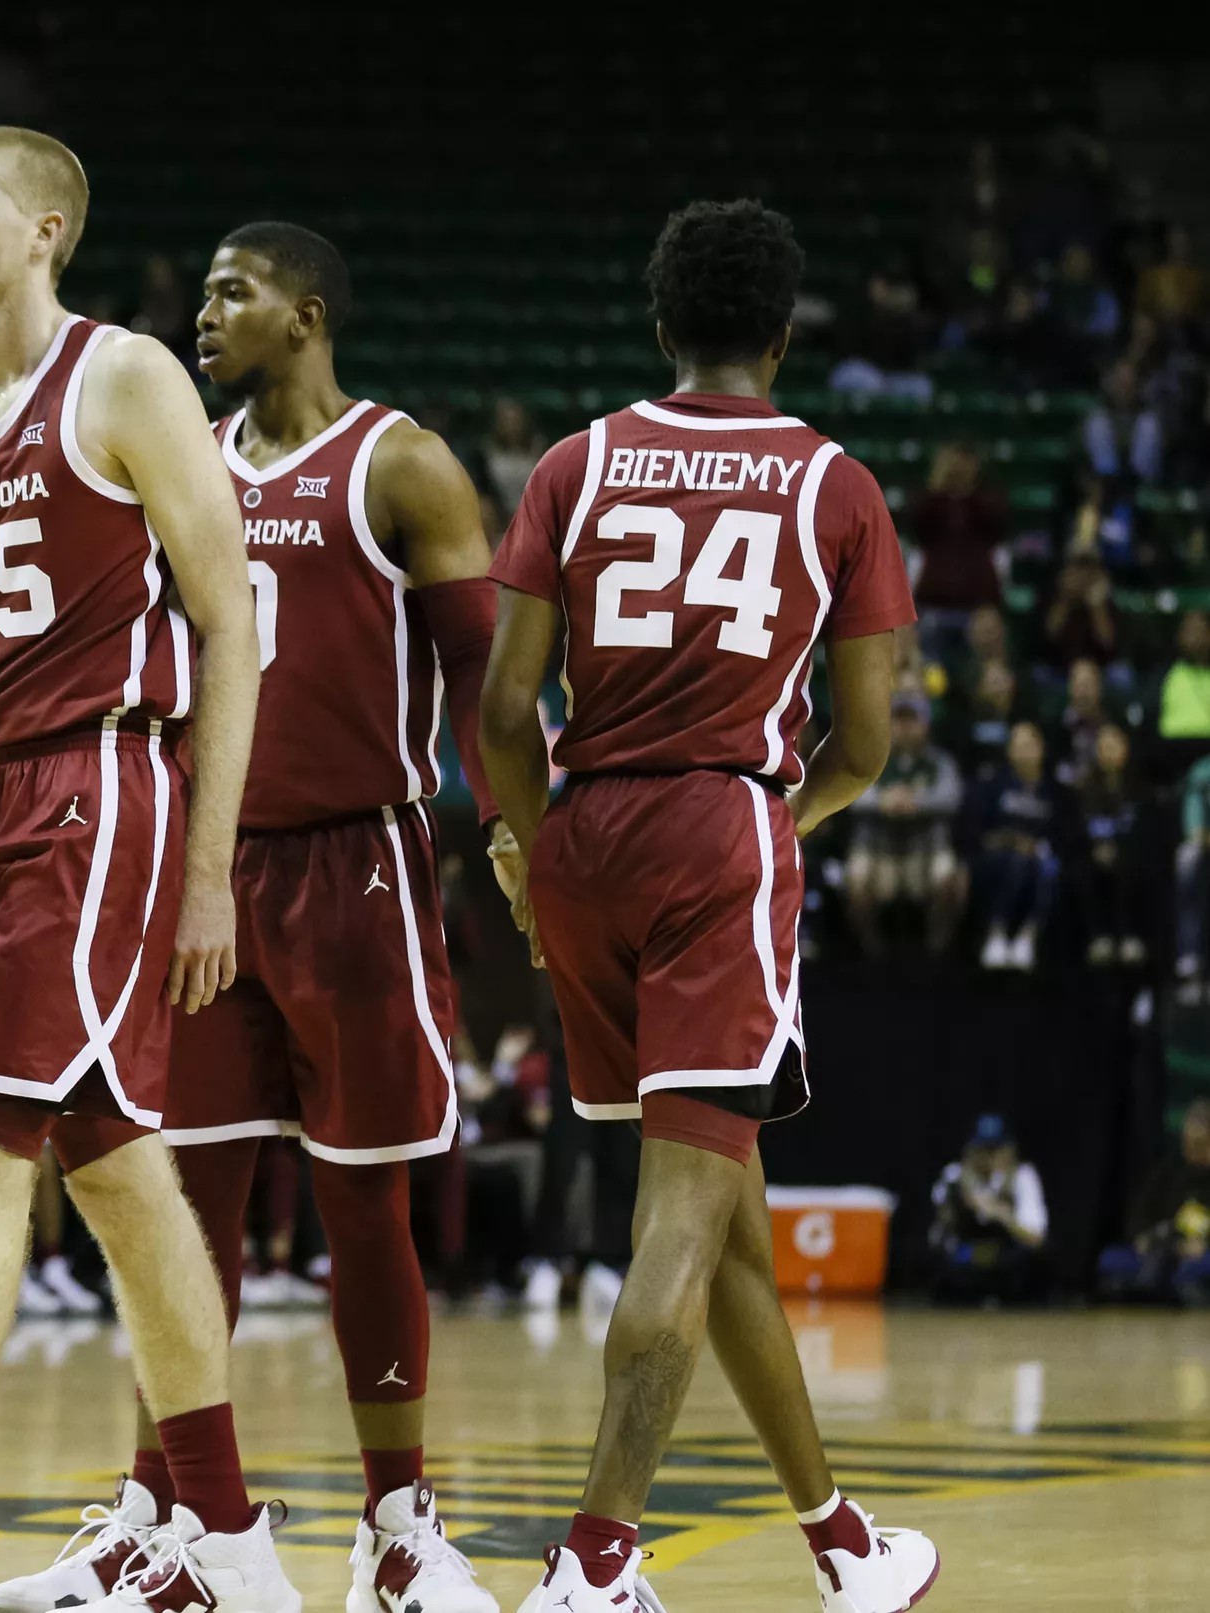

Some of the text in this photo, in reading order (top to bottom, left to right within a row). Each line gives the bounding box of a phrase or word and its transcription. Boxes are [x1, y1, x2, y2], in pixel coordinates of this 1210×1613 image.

[604, 448, 803, 496] BIENIEMY
[244, 518, 325, 547] HOMA
[593, 504, 783, 660] 24
